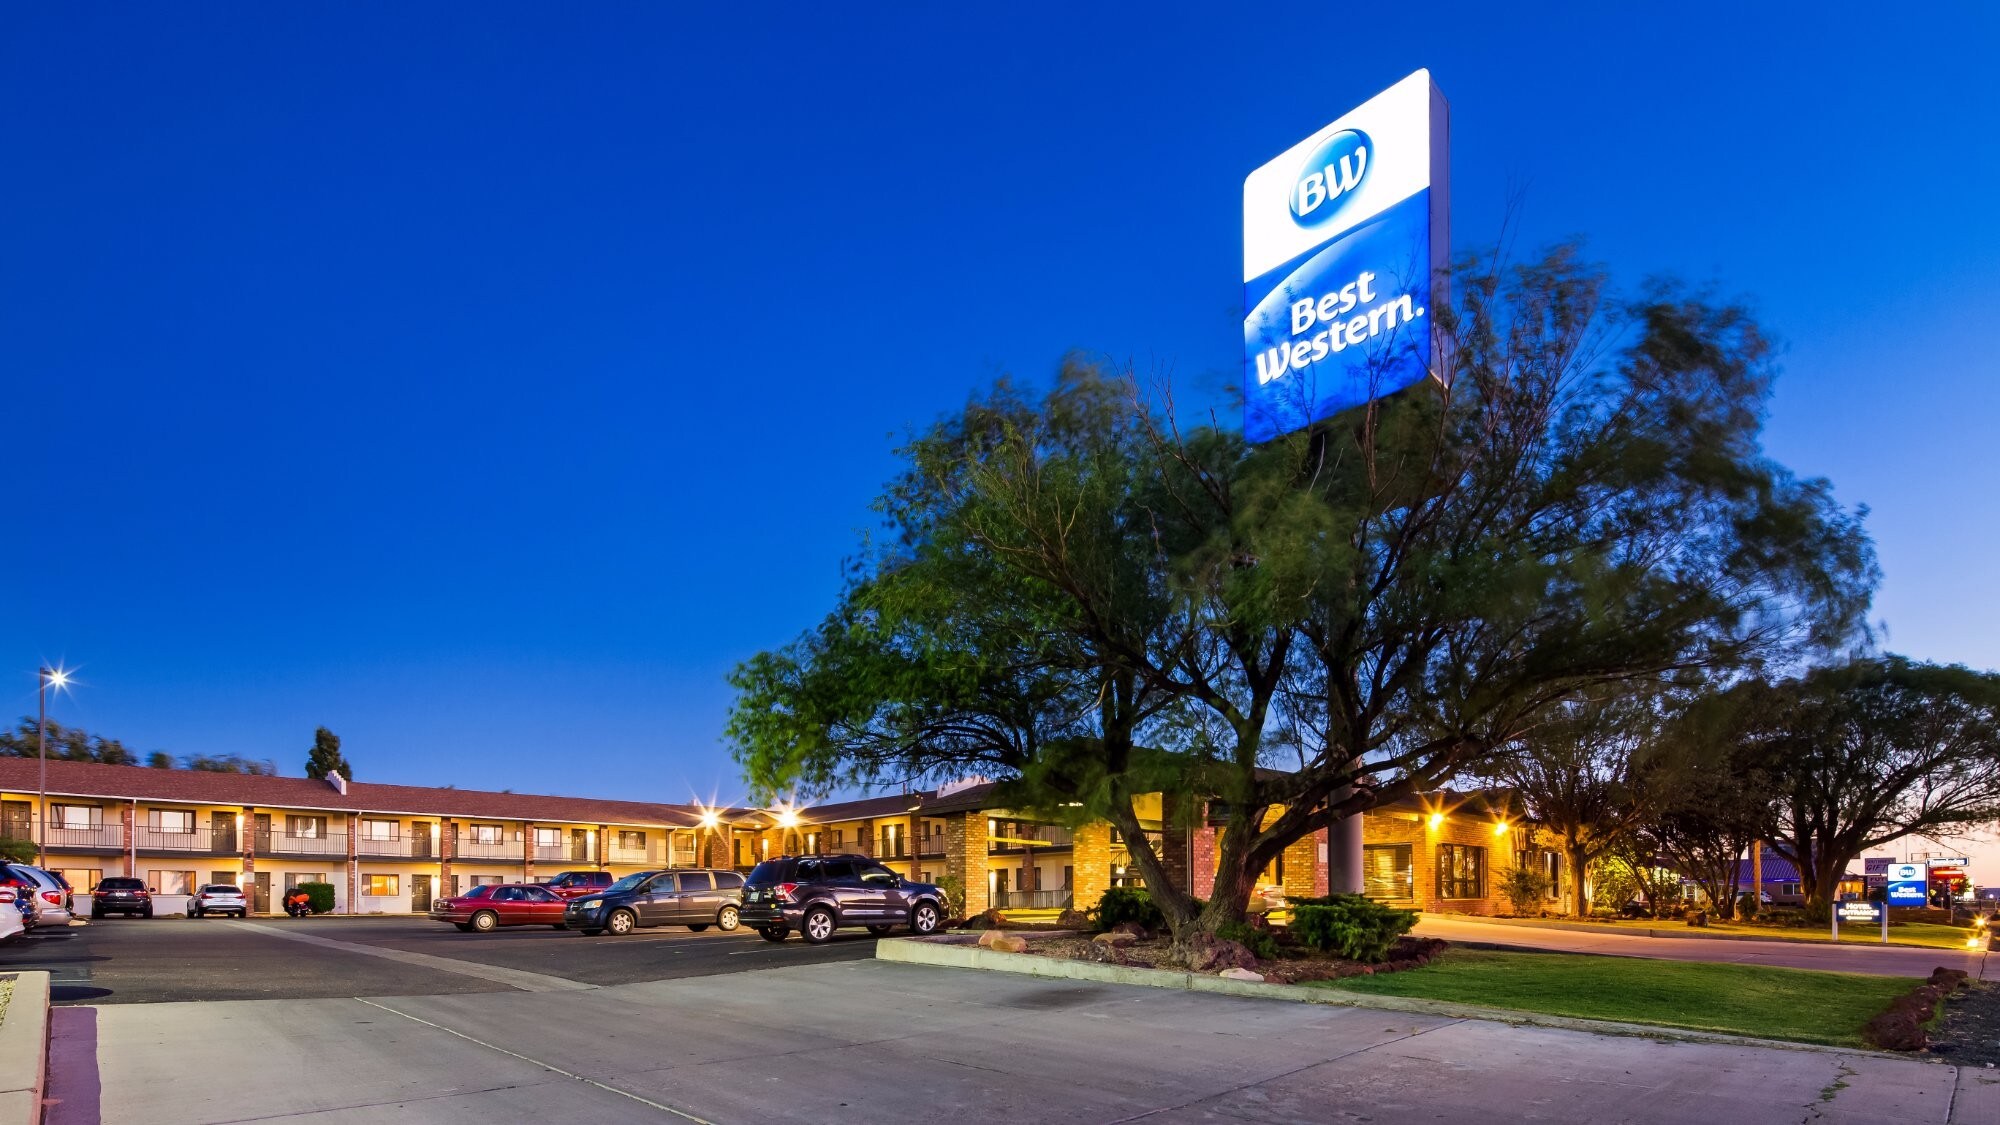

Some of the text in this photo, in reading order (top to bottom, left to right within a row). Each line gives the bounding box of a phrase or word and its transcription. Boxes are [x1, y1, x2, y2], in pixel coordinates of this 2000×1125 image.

[1298, 146, 1367, 216] BW
[1291, 271, 1376, 336] Best
[1255, 293, 1425, 386] Western.
